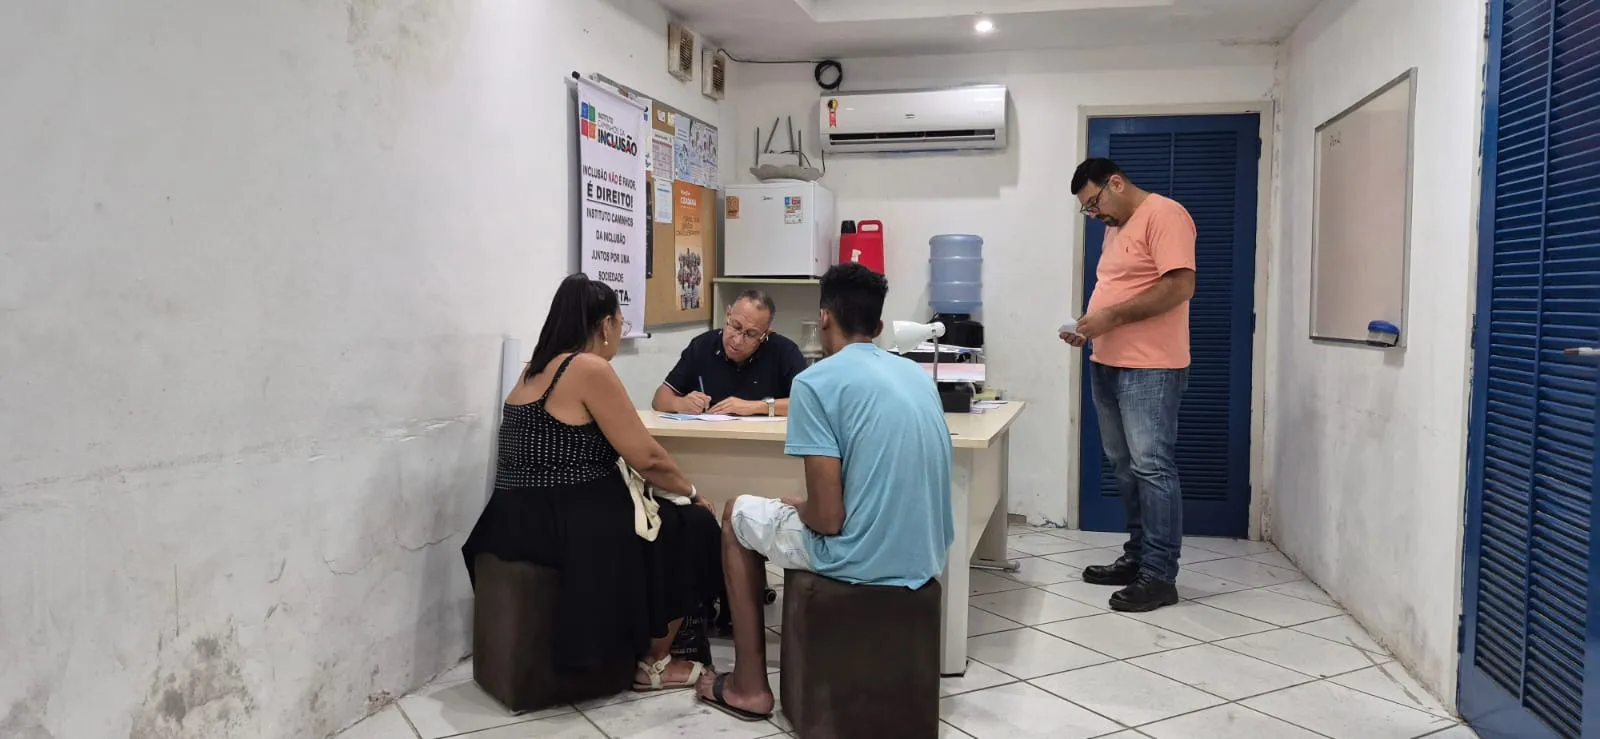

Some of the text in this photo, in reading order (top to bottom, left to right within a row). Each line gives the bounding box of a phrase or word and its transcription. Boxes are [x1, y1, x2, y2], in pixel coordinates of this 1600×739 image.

[598, 128, 637, 156] INCLUSÃO
[583, 164, 608, 182] INCLUSÃO
[608, 171, 618, 184] NÃO
[587, 180, 593, 198] É
[596, 185, 633, 209] DIREITO!
[587, 207, 611, 222] INSTITUTO
[596, 230, 626, 245] DA INCLUSÃO
[592, 249, 609, 262] JUNTOS
[610, 251, 620, 263] POR
[598, 270, 624, 283] SOCIEDADE
